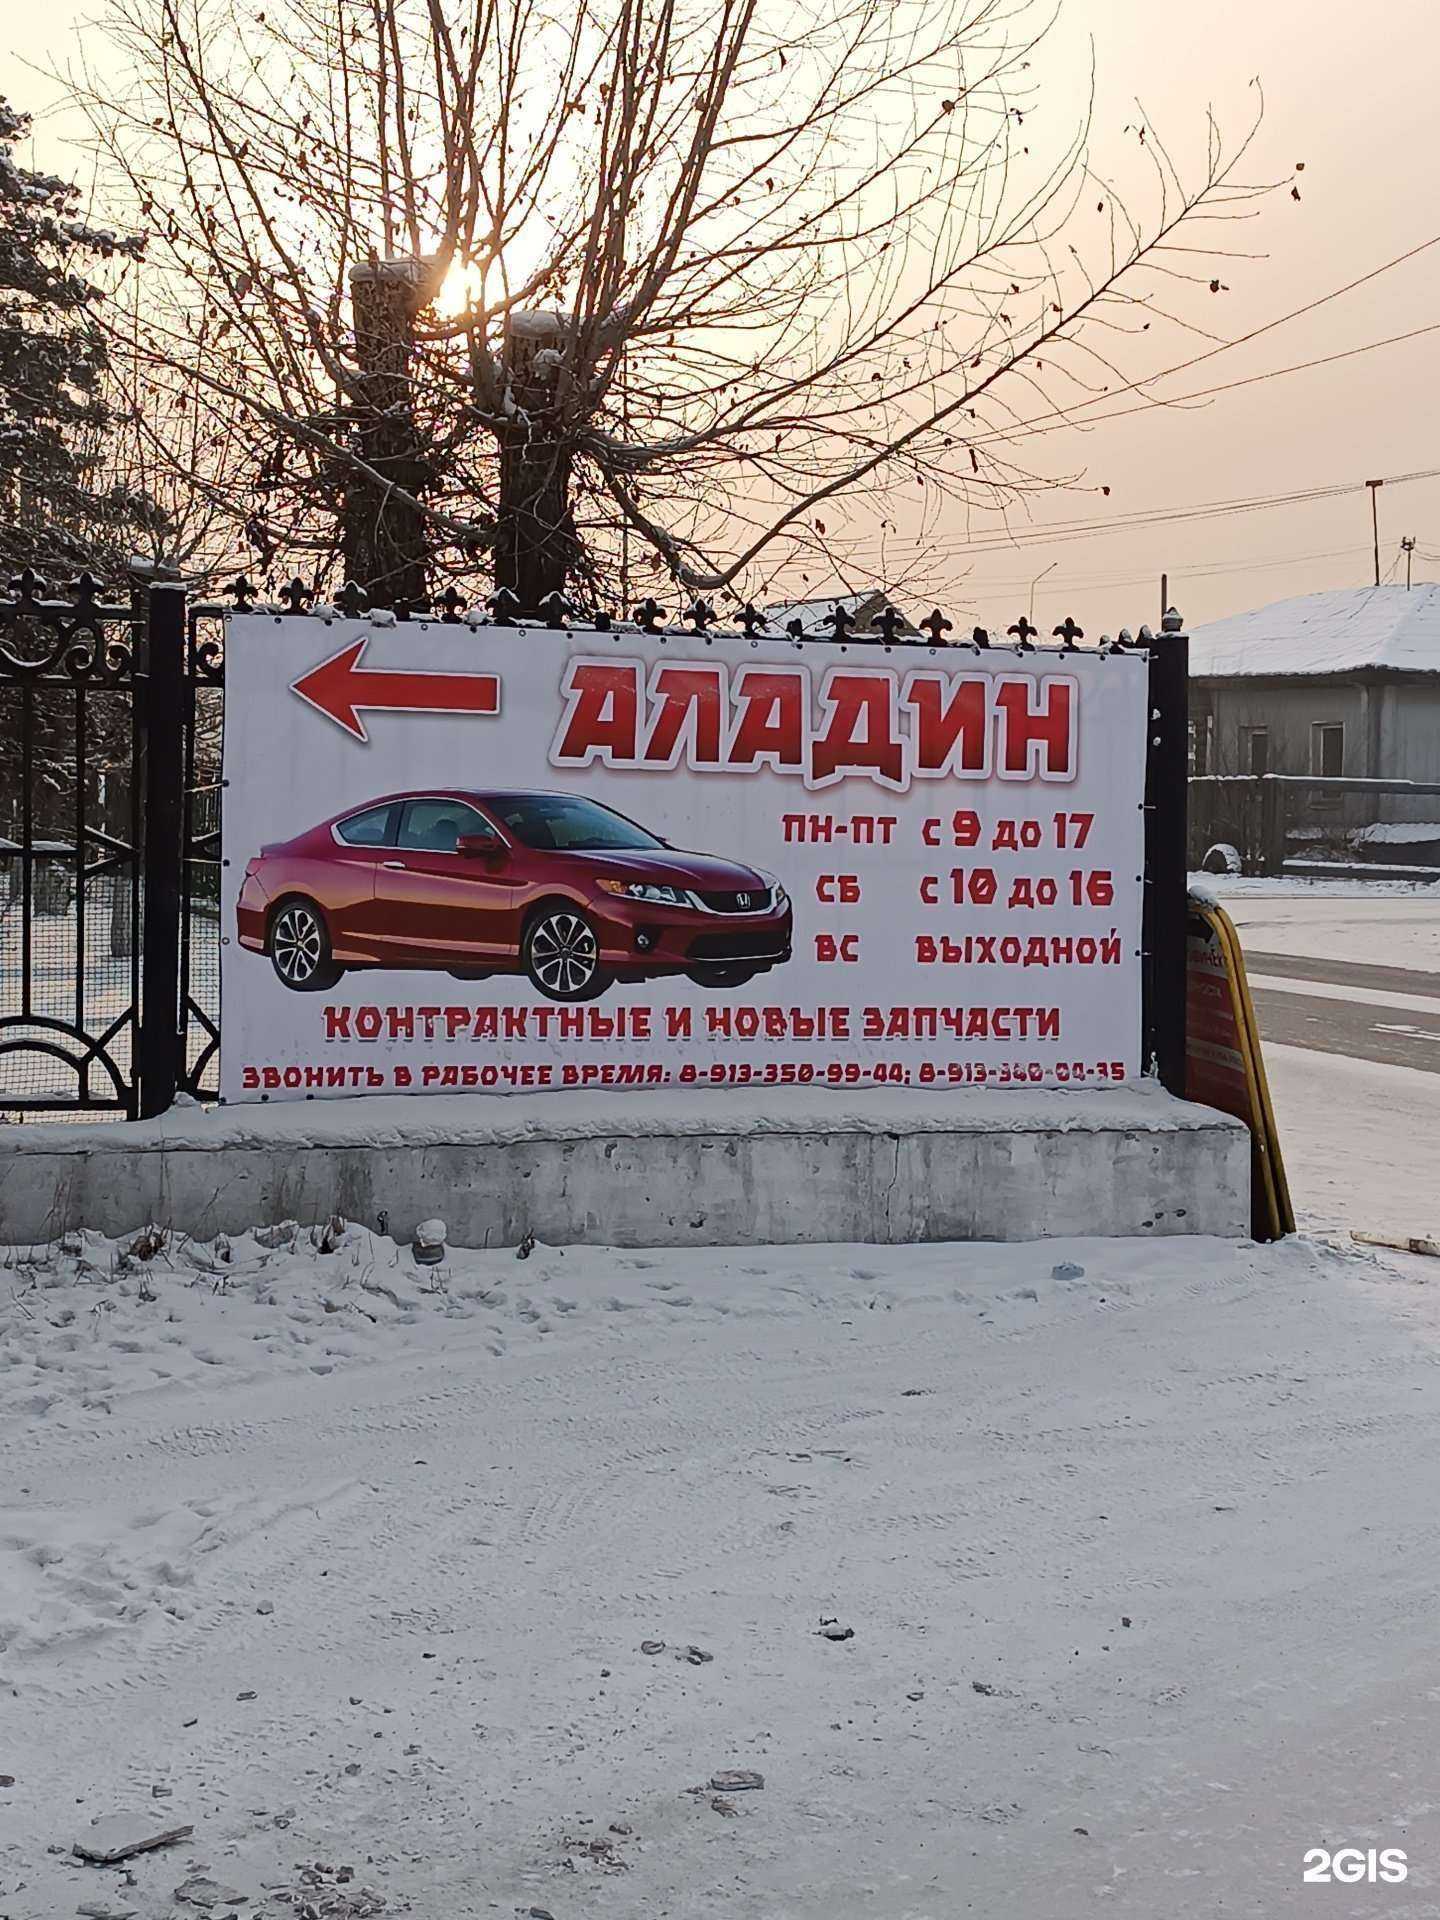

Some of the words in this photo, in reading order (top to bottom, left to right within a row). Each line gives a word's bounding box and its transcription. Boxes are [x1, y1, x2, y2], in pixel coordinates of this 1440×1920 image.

[557, 663, 1072, 785] АЛАДИН
[951, 810, 981, 847] 9
[1054, 812, 1094, 849] 17
[952, 867, 997, 905] 10
[1071, 870, 1114, 907] 16
[324, 1006, 652, 1039] КОНТРАКТНЫЕ
[666, 1007, 692, 1037] И
[704, 1006, 849, 1038] НОВЫЕ
[863, 1006, 1060, 1038] ЗАПЧАСТИ
[242, 1066, 384, 1089] ЗВОНИТЬ
[394, 1066, 413, 1087] В
[423, 1065, 552, 1087] РАБОЧЕЕ
[563, 1064, 671, 1085] ВРЕМЯ:
